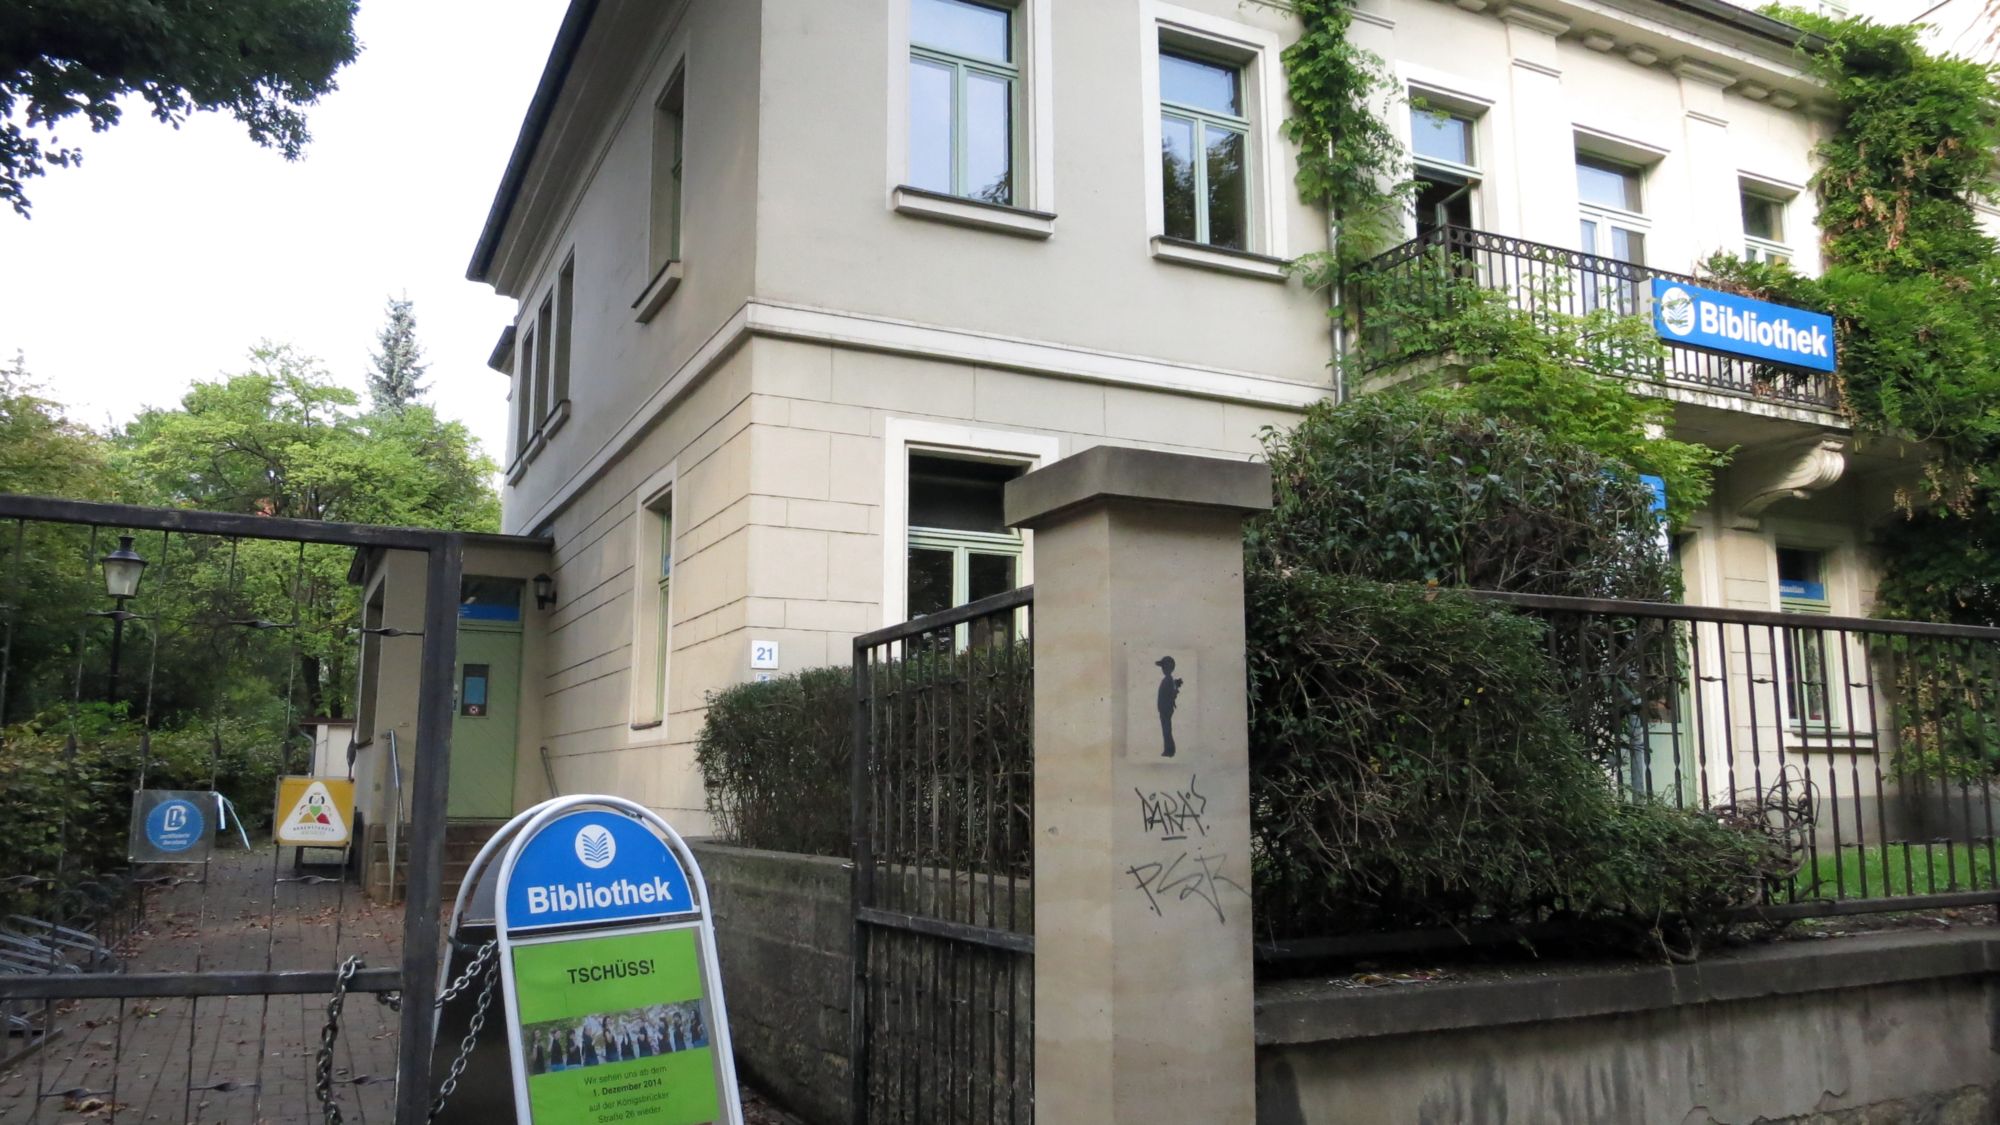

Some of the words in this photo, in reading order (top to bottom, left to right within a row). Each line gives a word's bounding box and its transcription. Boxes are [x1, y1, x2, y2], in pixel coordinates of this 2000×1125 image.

[1700, 300, 1828, 357] Bibliothek
[756, 647, 773, 660] 21
[527, 876, 672, 914] Bibliothek
[567, 959, 655, 984] TSCHÜSS!
[584, 1076, 597, 1085] Wir
[624, 1070, 638, 1080] uns
[602, 1082, 641, 1096] Dezember
[643, 1078, 662, 1088] 2014
